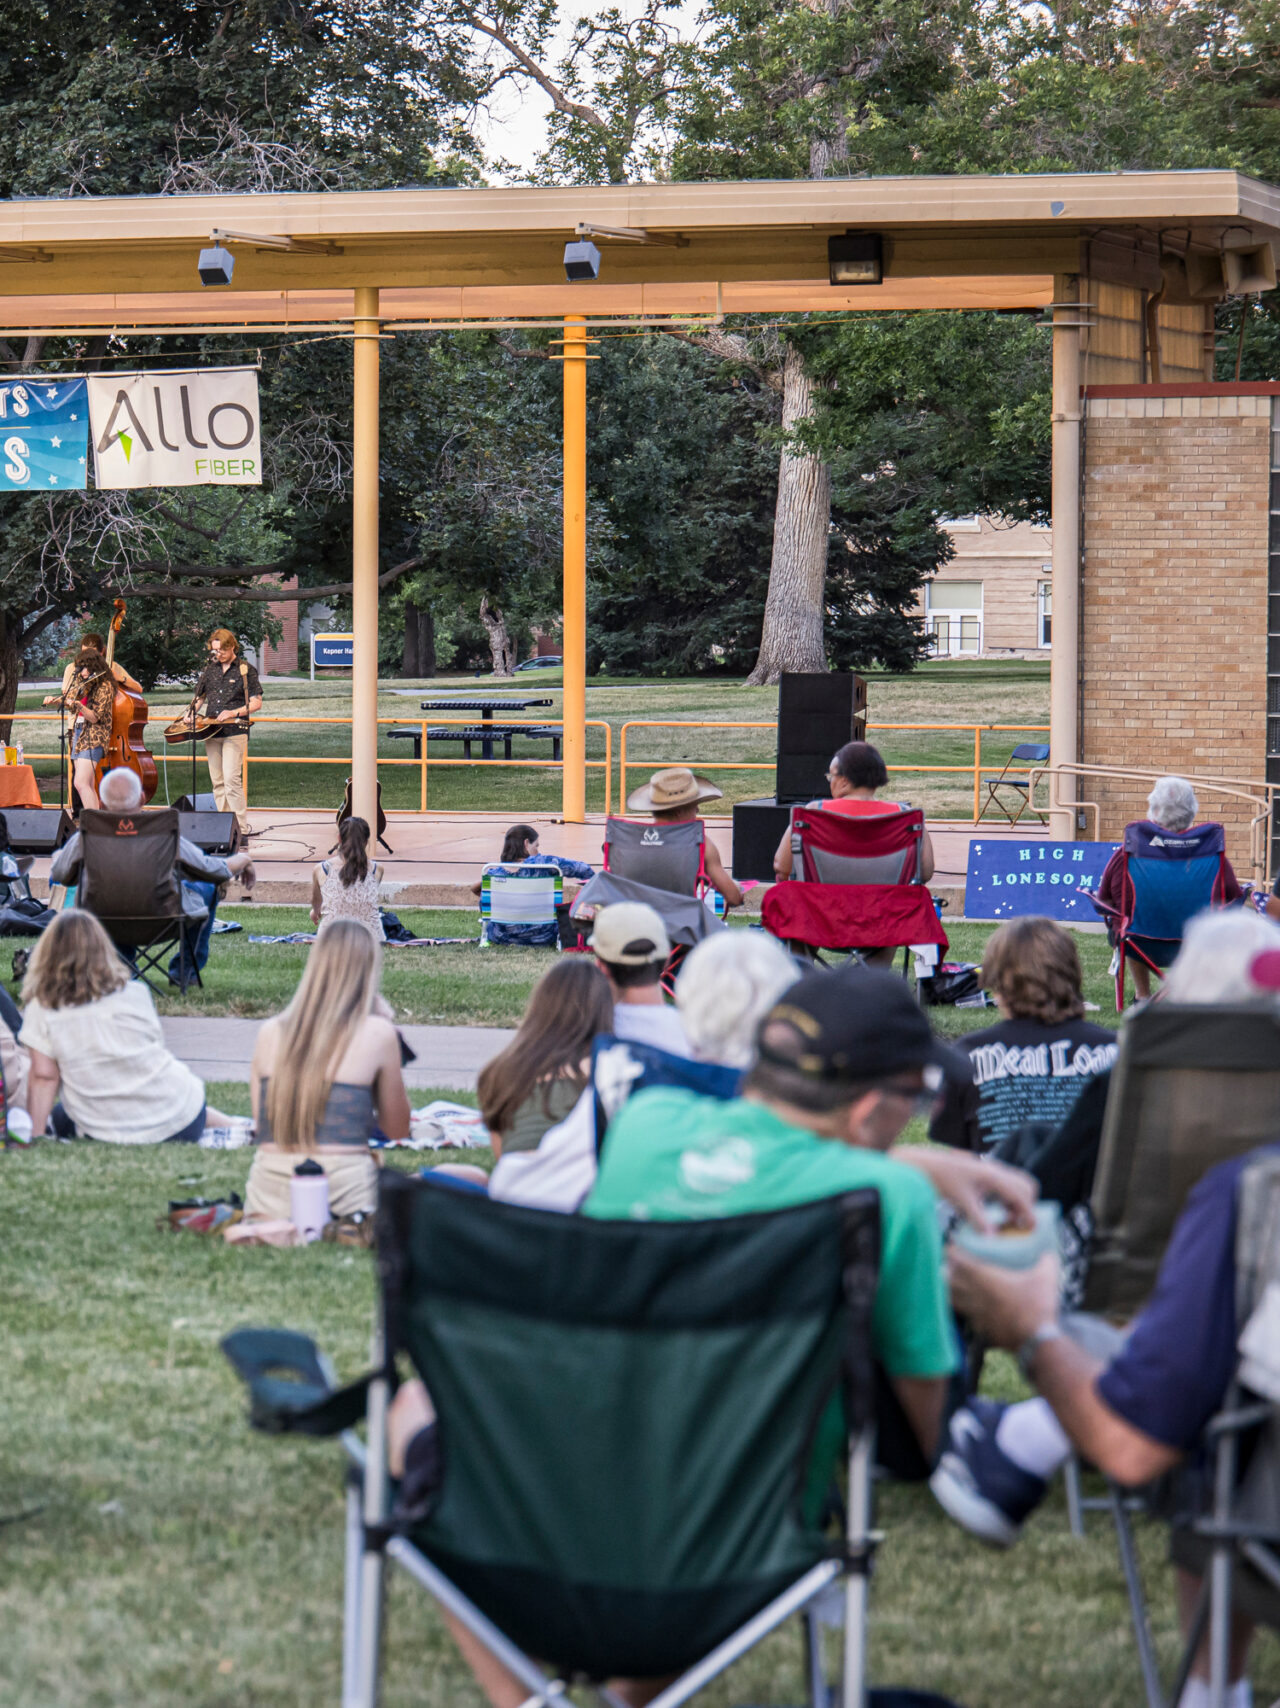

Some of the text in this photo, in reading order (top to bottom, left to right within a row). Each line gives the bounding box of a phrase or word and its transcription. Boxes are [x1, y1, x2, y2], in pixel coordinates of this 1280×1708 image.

[195, 459, 256, 476] FIBER
[323, 647, 343, 656] Kepner
[1019, 847, 1085, 861] HIGH
[992, 872, 1103, 888] LONESOM
[969, 1041, 1049, 1086] Meat
